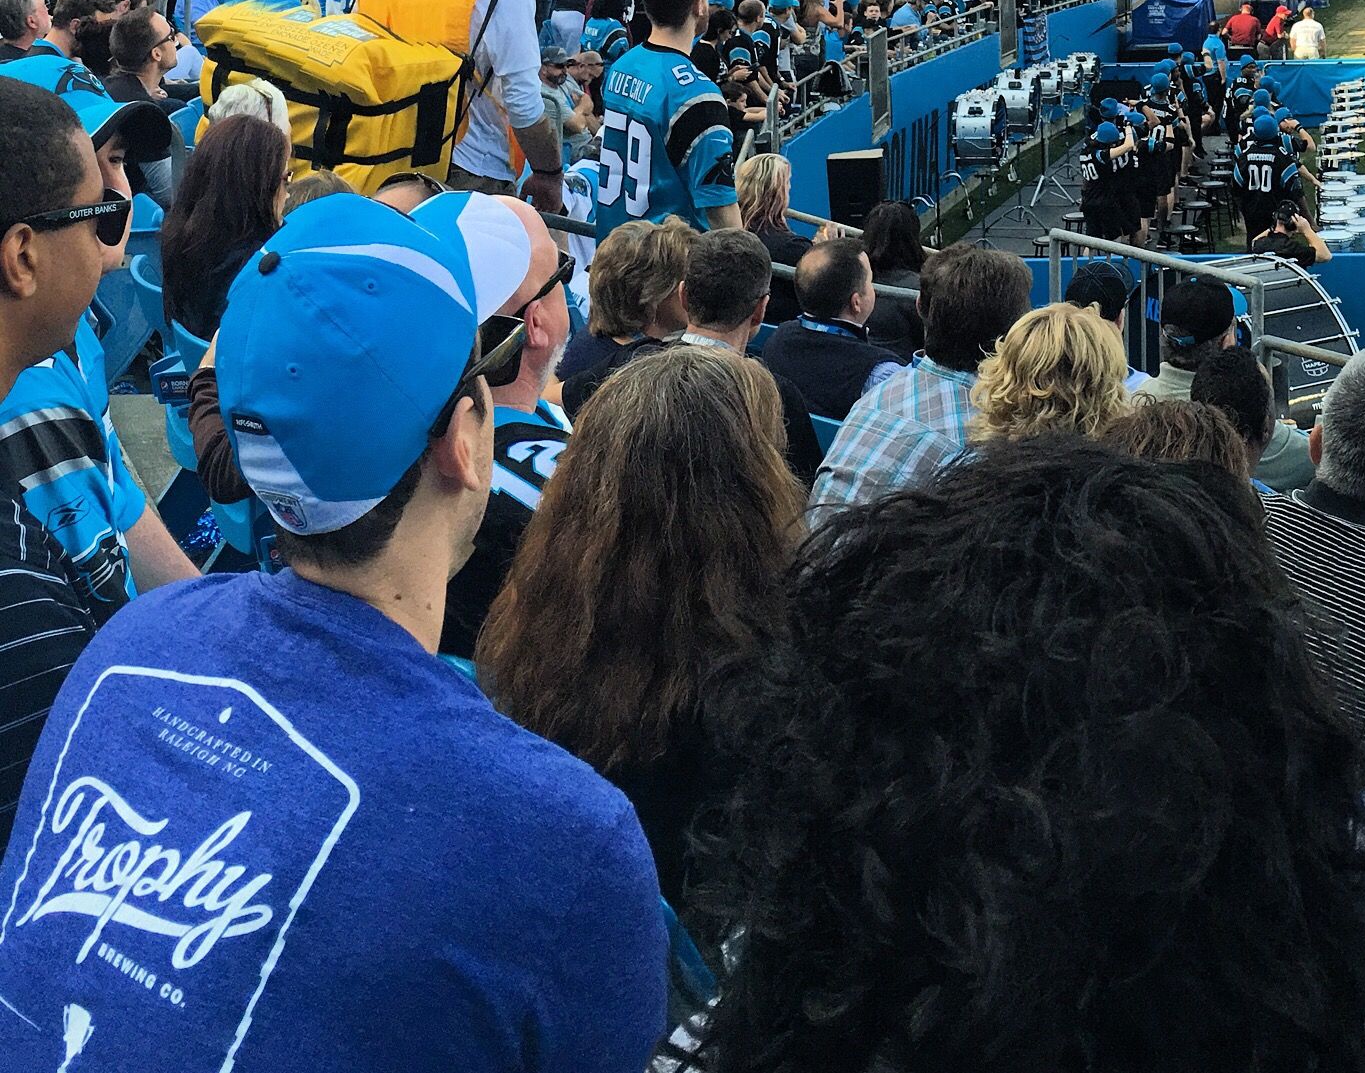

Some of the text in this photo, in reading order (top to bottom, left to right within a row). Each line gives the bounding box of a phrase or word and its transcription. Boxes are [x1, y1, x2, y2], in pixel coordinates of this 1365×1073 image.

[608, 70, 653, 105] KUECHLY
[597, 108, 652, 218] 59
[1248, 164, 1273, 193] 00
[69, 202, 117, 220] OUTER BANKS
[152, 706, 273, 775] HANDCRAFTED IN
[158, 728, 247, 779] RALEIGH NC
[15, 775, 274, 970] Trophy
[97, 941, 187, 1009] BREWING CO.
